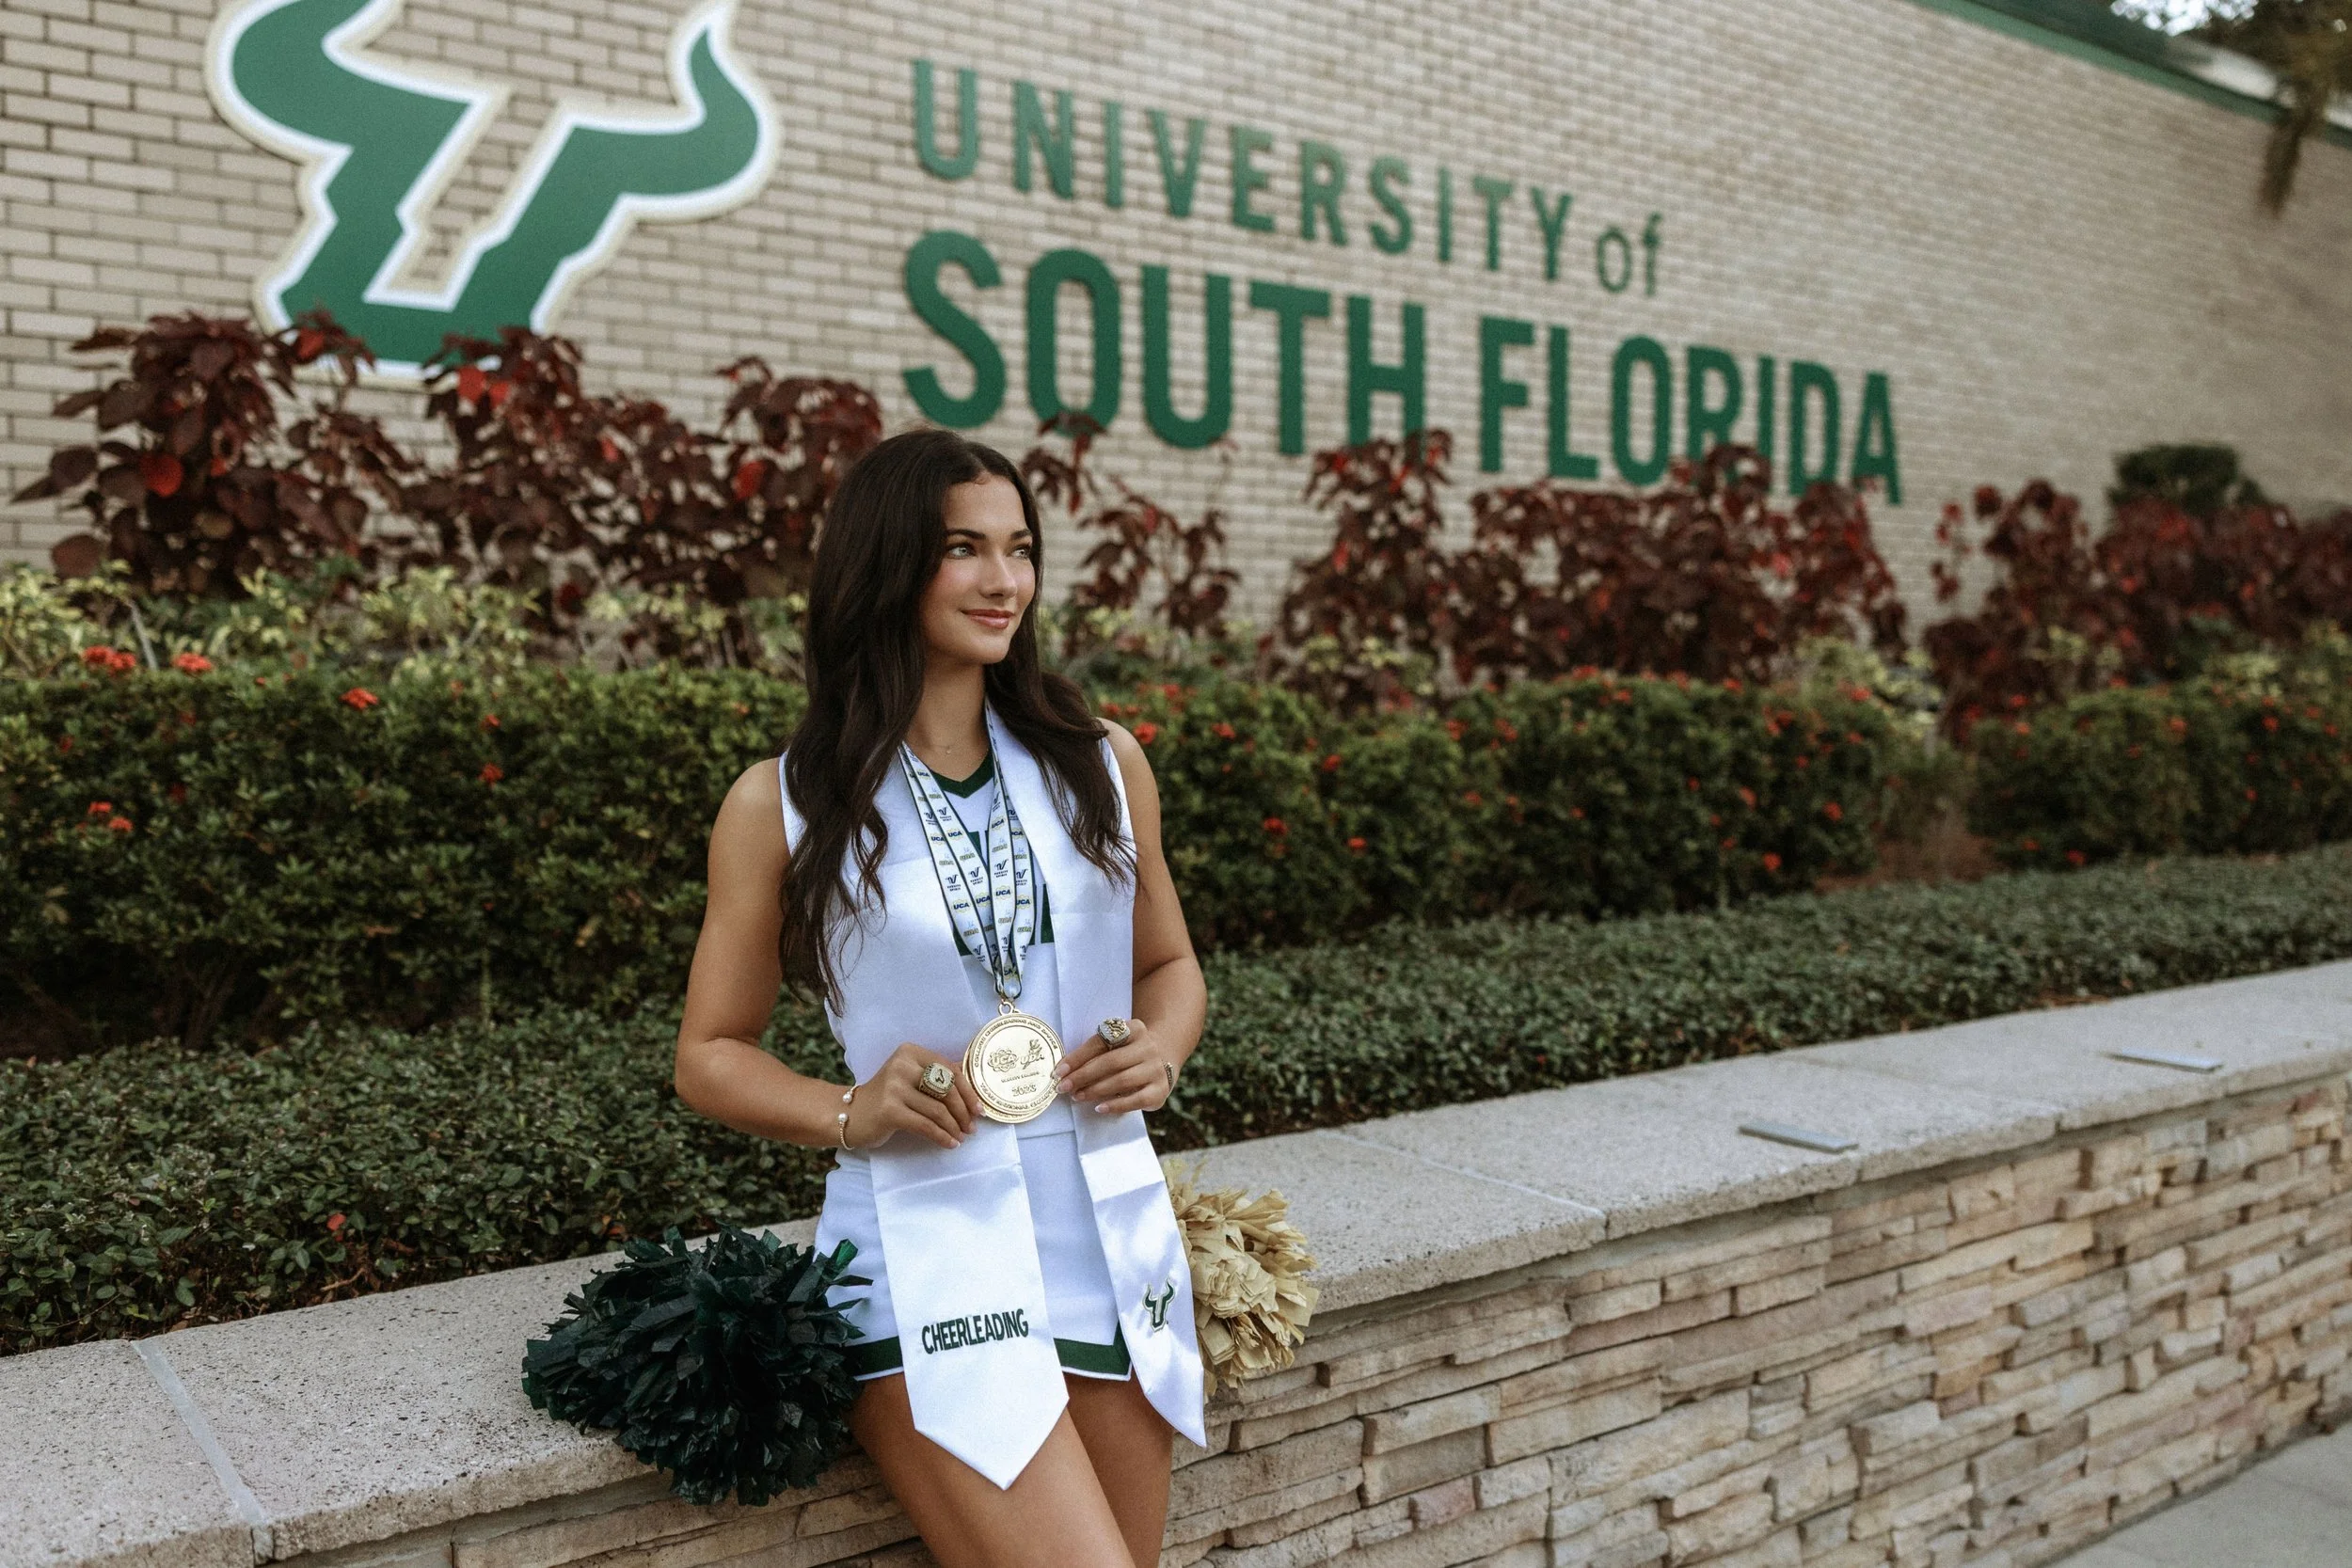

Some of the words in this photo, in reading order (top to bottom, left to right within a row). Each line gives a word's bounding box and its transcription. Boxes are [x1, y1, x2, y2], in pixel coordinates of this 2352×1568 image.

[912, 58, 1572, 281] UNIVERSITY
[1597, 212, 1663, 297] of
[902, 229, 1426, 455] SOUTH
[1480, 313, 1904, 506] FLORIDA
[976, 895, 991, 904] UCA
[921, 1307, 1029, 1355] CHEERLEADING
